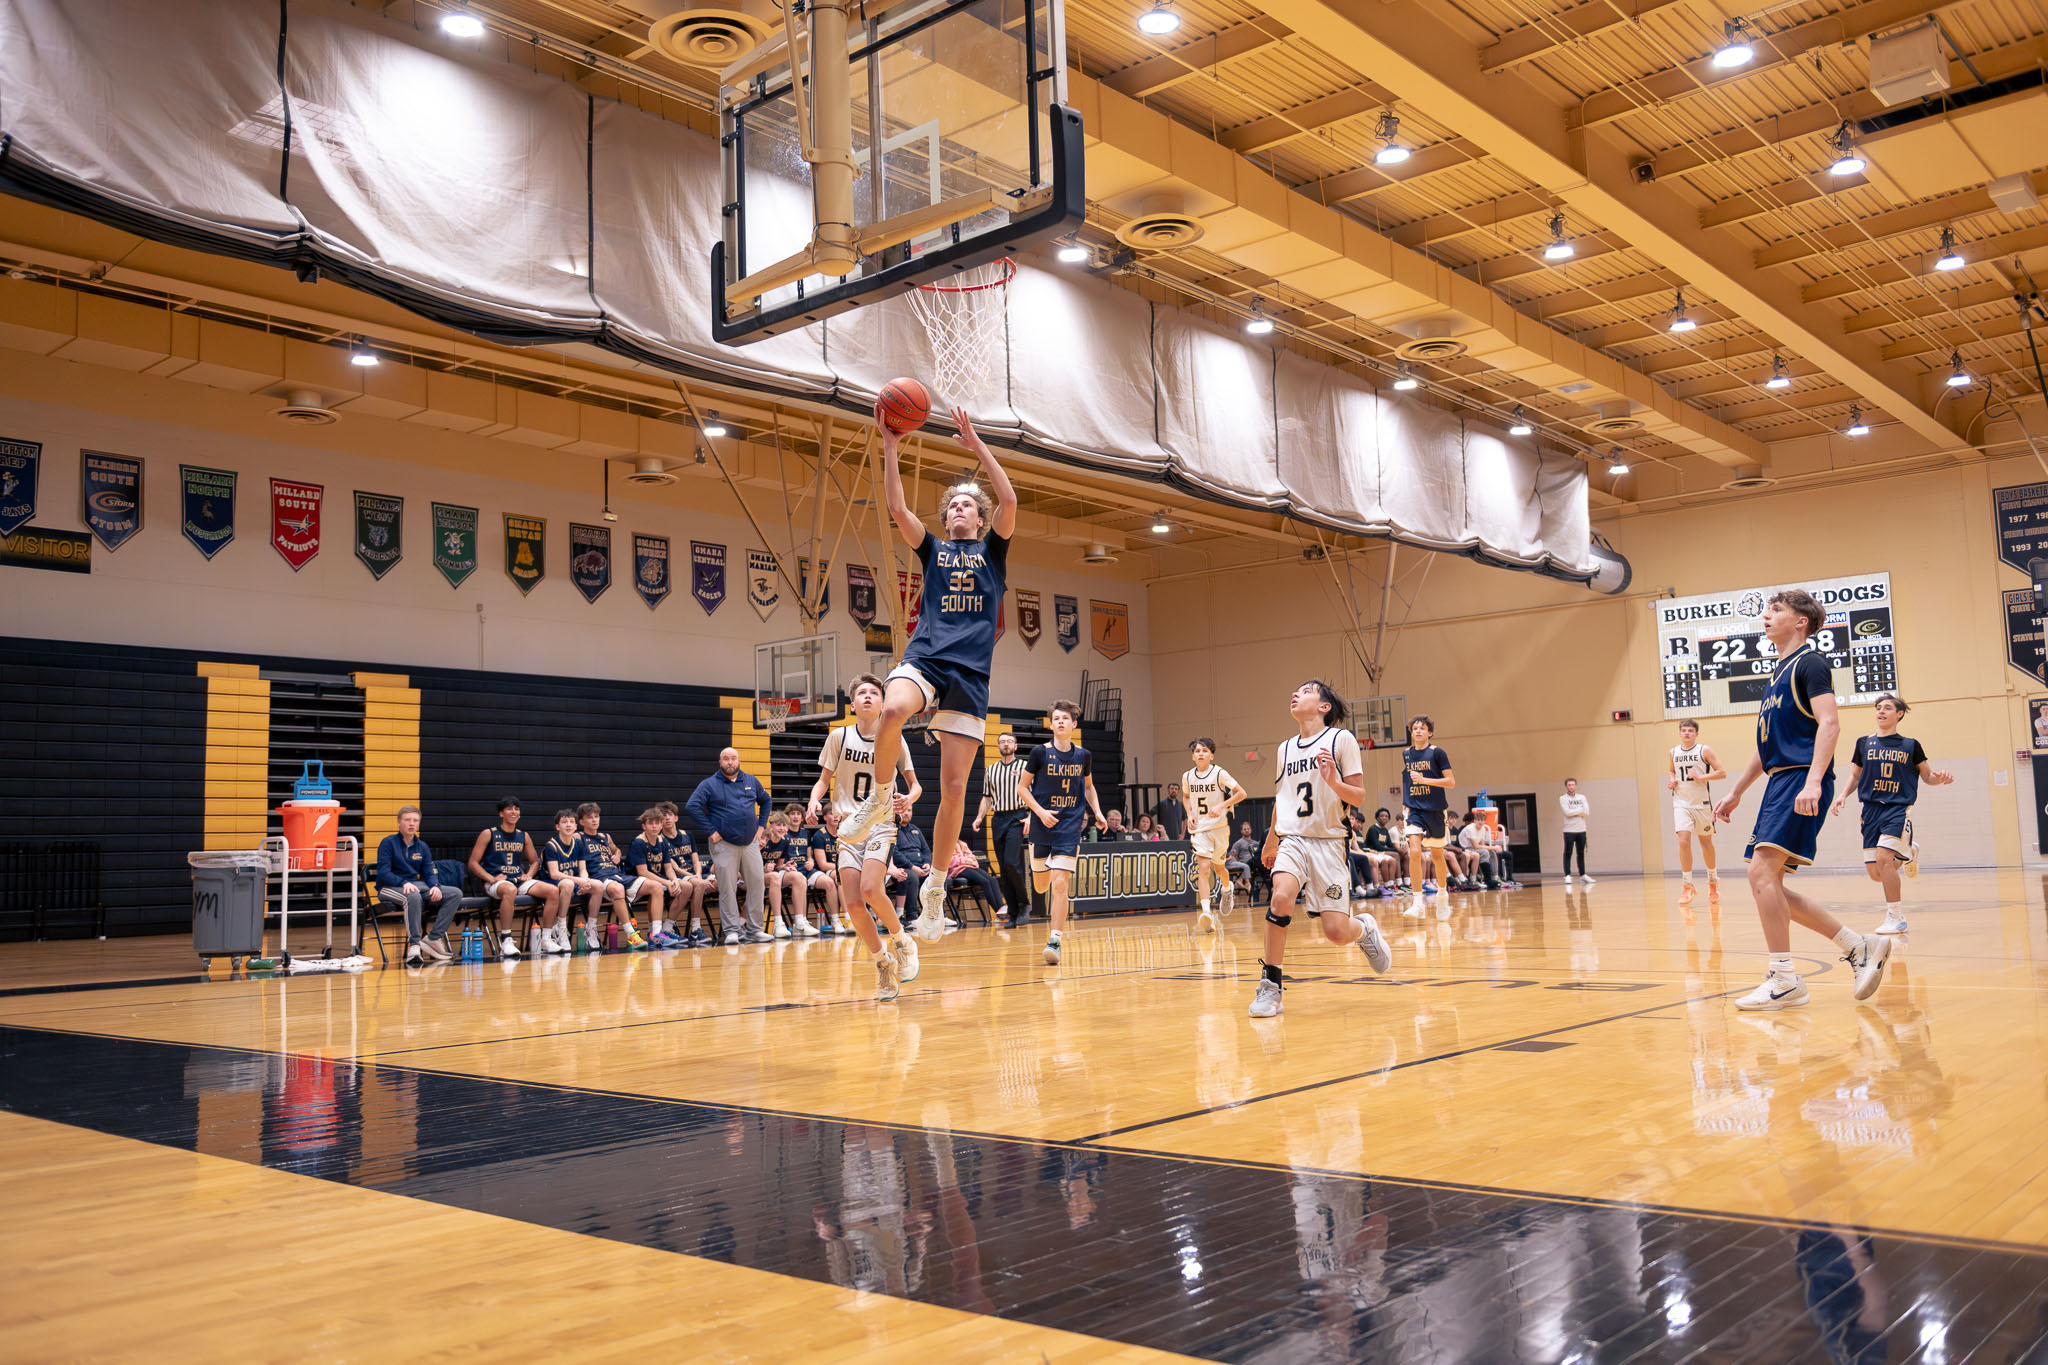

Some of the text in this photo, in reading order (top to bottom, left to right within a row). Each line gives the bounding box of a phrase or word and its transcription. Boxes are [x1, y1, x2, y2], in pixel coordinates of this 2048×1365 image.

[91, 471, 134, 486] SOUTH
[185, 471, 233, 486] MILLARD
[188, 484, 230, 498] NORTH
[274, 486, 320, 500] MILLARD
[1, 504, 32, 516] JAYS
[110, 499, 135, 508] STORM
[279, 498, 316, 511] SOUTH
[437, 508, 474, 521] OMAHA
[2008, 514, 2029, 524] 1977
[90, 515, 133, 531] STORM
[7, 536, 89, 560] VISITOR
[277, 535, 319, 552] PATRIOTS
[2011, 543, 2032, 553] 1993
[695, 546, 723, 557] OMAHA
[694, 555, 726, 566] CENTRAL
[949, 569, 975, 592] 35
[697, 588, 722, 600] EAGLES
[2008, 593, 2028, 604] GIRLS
[940, 595, 983, 613] SOUTH
[1664, 602, 1731, 623] BURKE
[1669, 637, 1689, 656] B
[1712, 639, 1747, 663] 22
[1768, 642, 1777, 654] 4
[1833, 658, 1842, 668] 0
[1858, 656, 1863, 665] 1
[1709, 670, 1717, 680] 2
[1857, 675, 1867, 683] 10
[1674, 754, 1699, 763] BURKE
[1867, 748, 1909, 765] ELKHORN
[1047, 763, 1083, 777] ELKHORN
[1880, 762, 1893, 778] 10
[853, 772, 872, 802] 0
[1061, 778, 1071, 794] 4
[1190, 783, 1215, 793] BURKE
[1409, 785, 1431, 796] SOUTH
[1050, 795, 1077, 808] SOUTH
[1296, 781, 1313, 817] 3
[1197, 797, 1208, 815] 5
[495, 841, 523, 852] ELKHORN
[506, 852, 514, 865] 3
[1112, 853, 1186, 895] BULLDOGS
